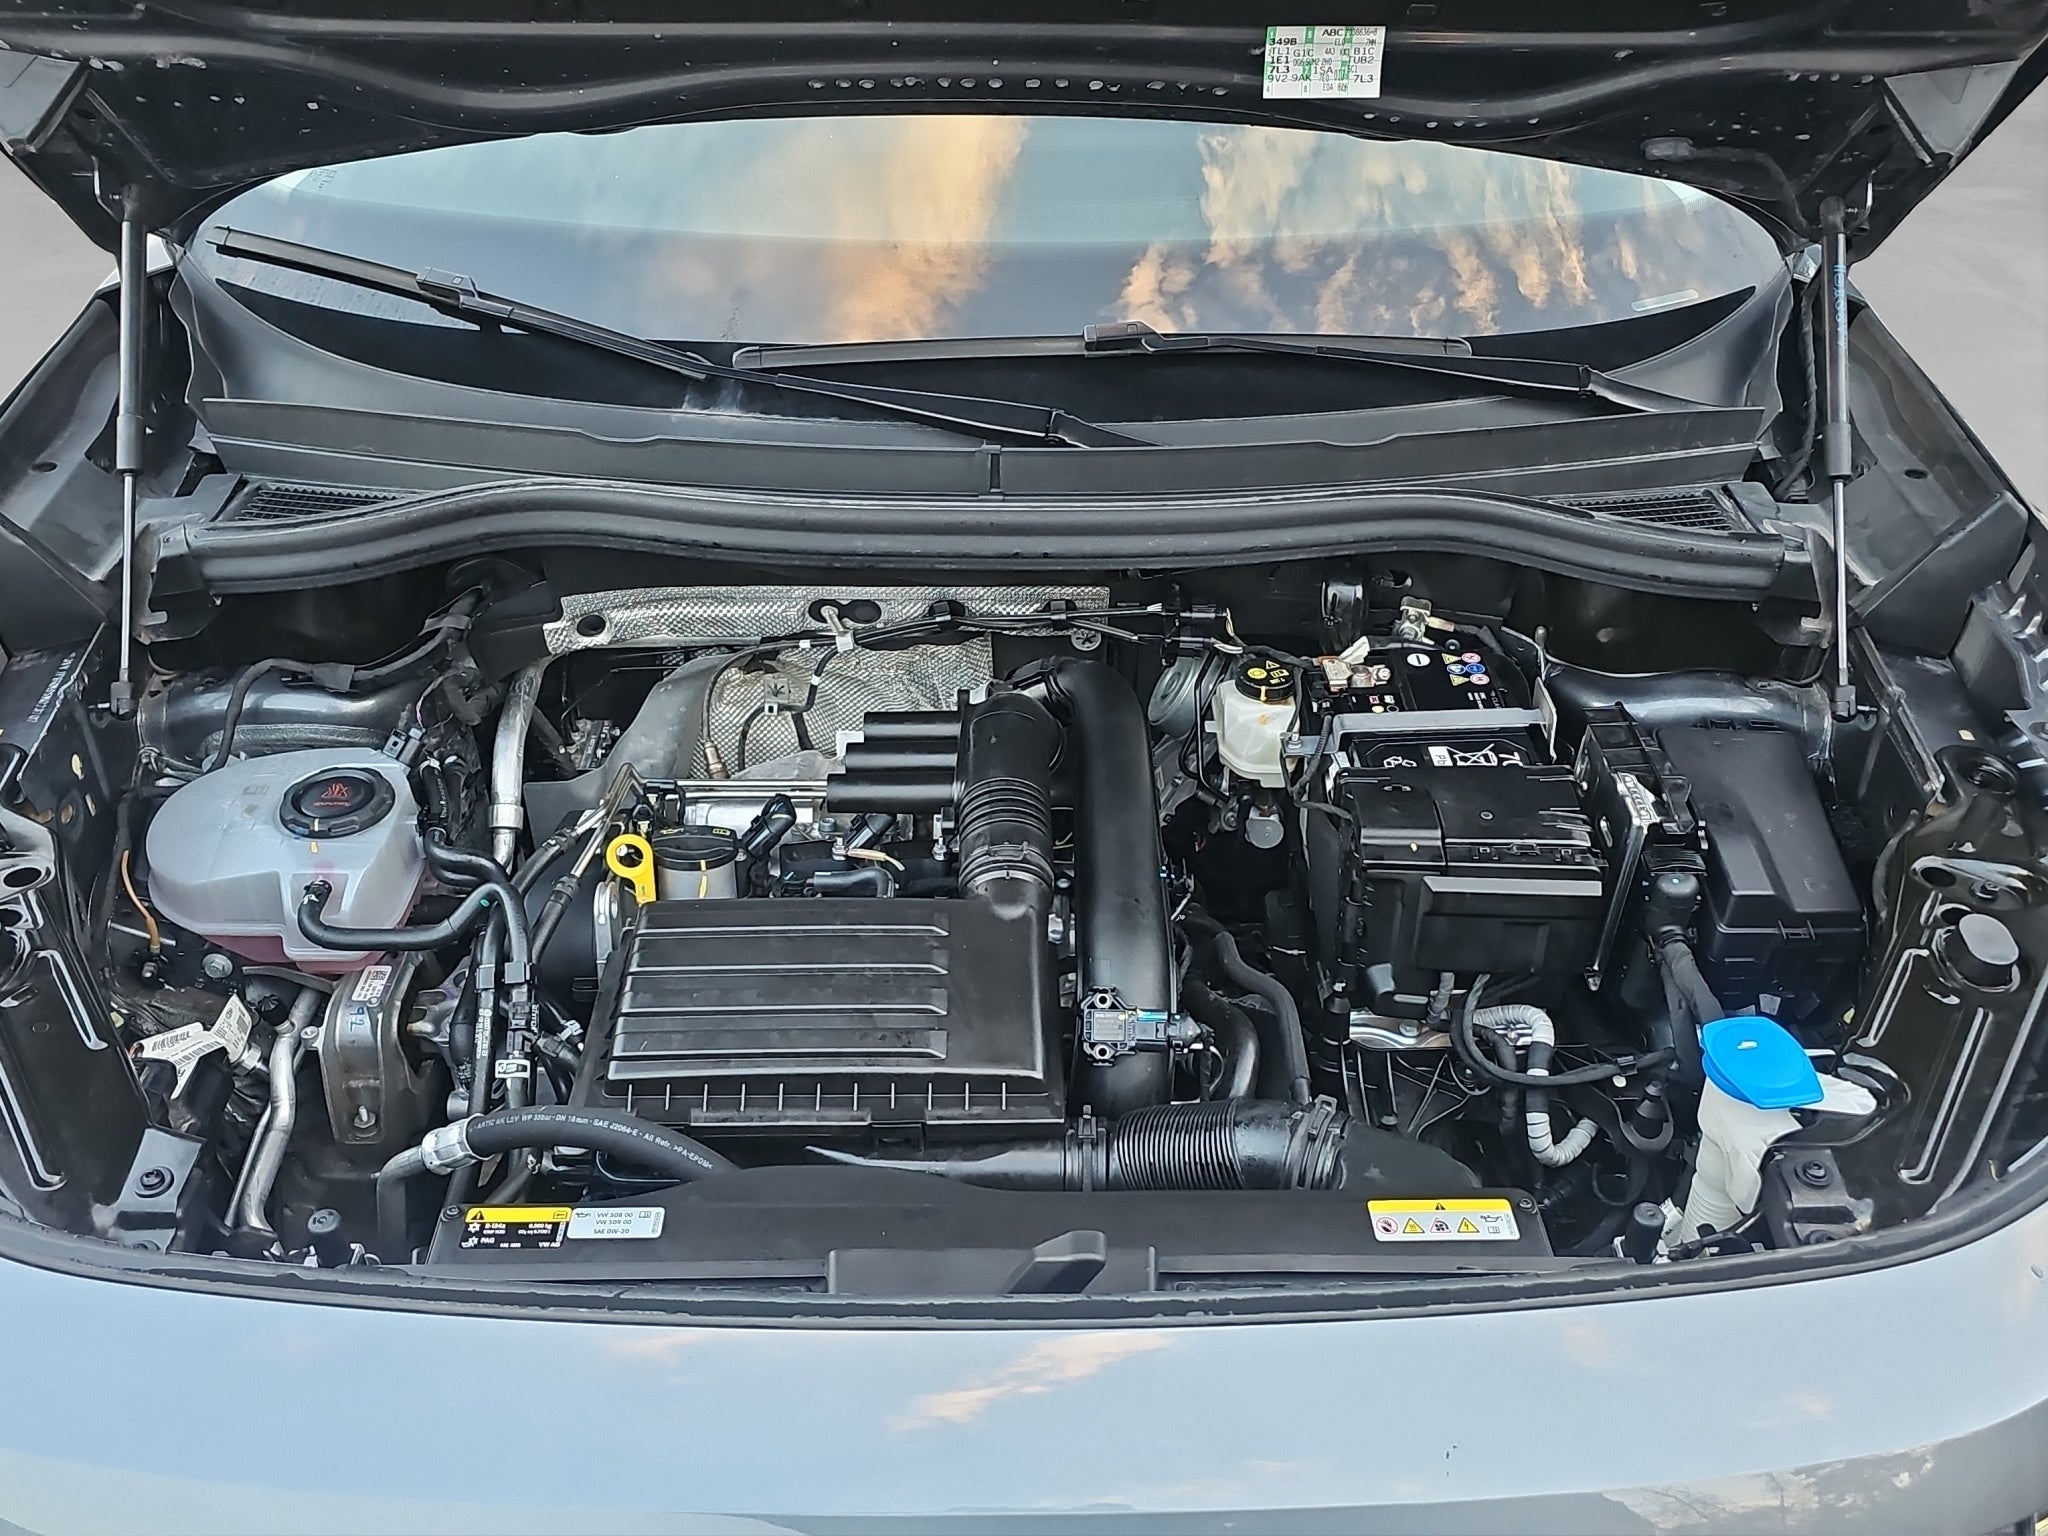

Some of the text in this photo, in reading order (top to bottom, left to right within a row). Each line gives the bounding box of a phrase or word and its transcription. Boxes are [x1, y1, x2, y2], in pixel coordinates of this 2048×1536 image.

[1321, 28, 1343, 36] ABC
[1268, 37, 1298, 46] 349B
[1270, 46, 1290, 55] TL1
[1293, 48, 1315, 57] G1C
[1353, 46, 1375, 55] B1C
[1270, 55, 1290, 64] 1E1
[1348, 55, 1375, 64] TUB2
[1270, 65, 1290, 74] 7L3
[1312, 66, 1334, 75] 1SA
[1267, 74, 1312, 83] 9V2 9AK
[1353, 74, 1374, 83] 7L3
[1434, 754, 1448, 765] Pb
[592, 1118, 609, 1128] SAE
[480, 1236, 496, 1244] PAG
